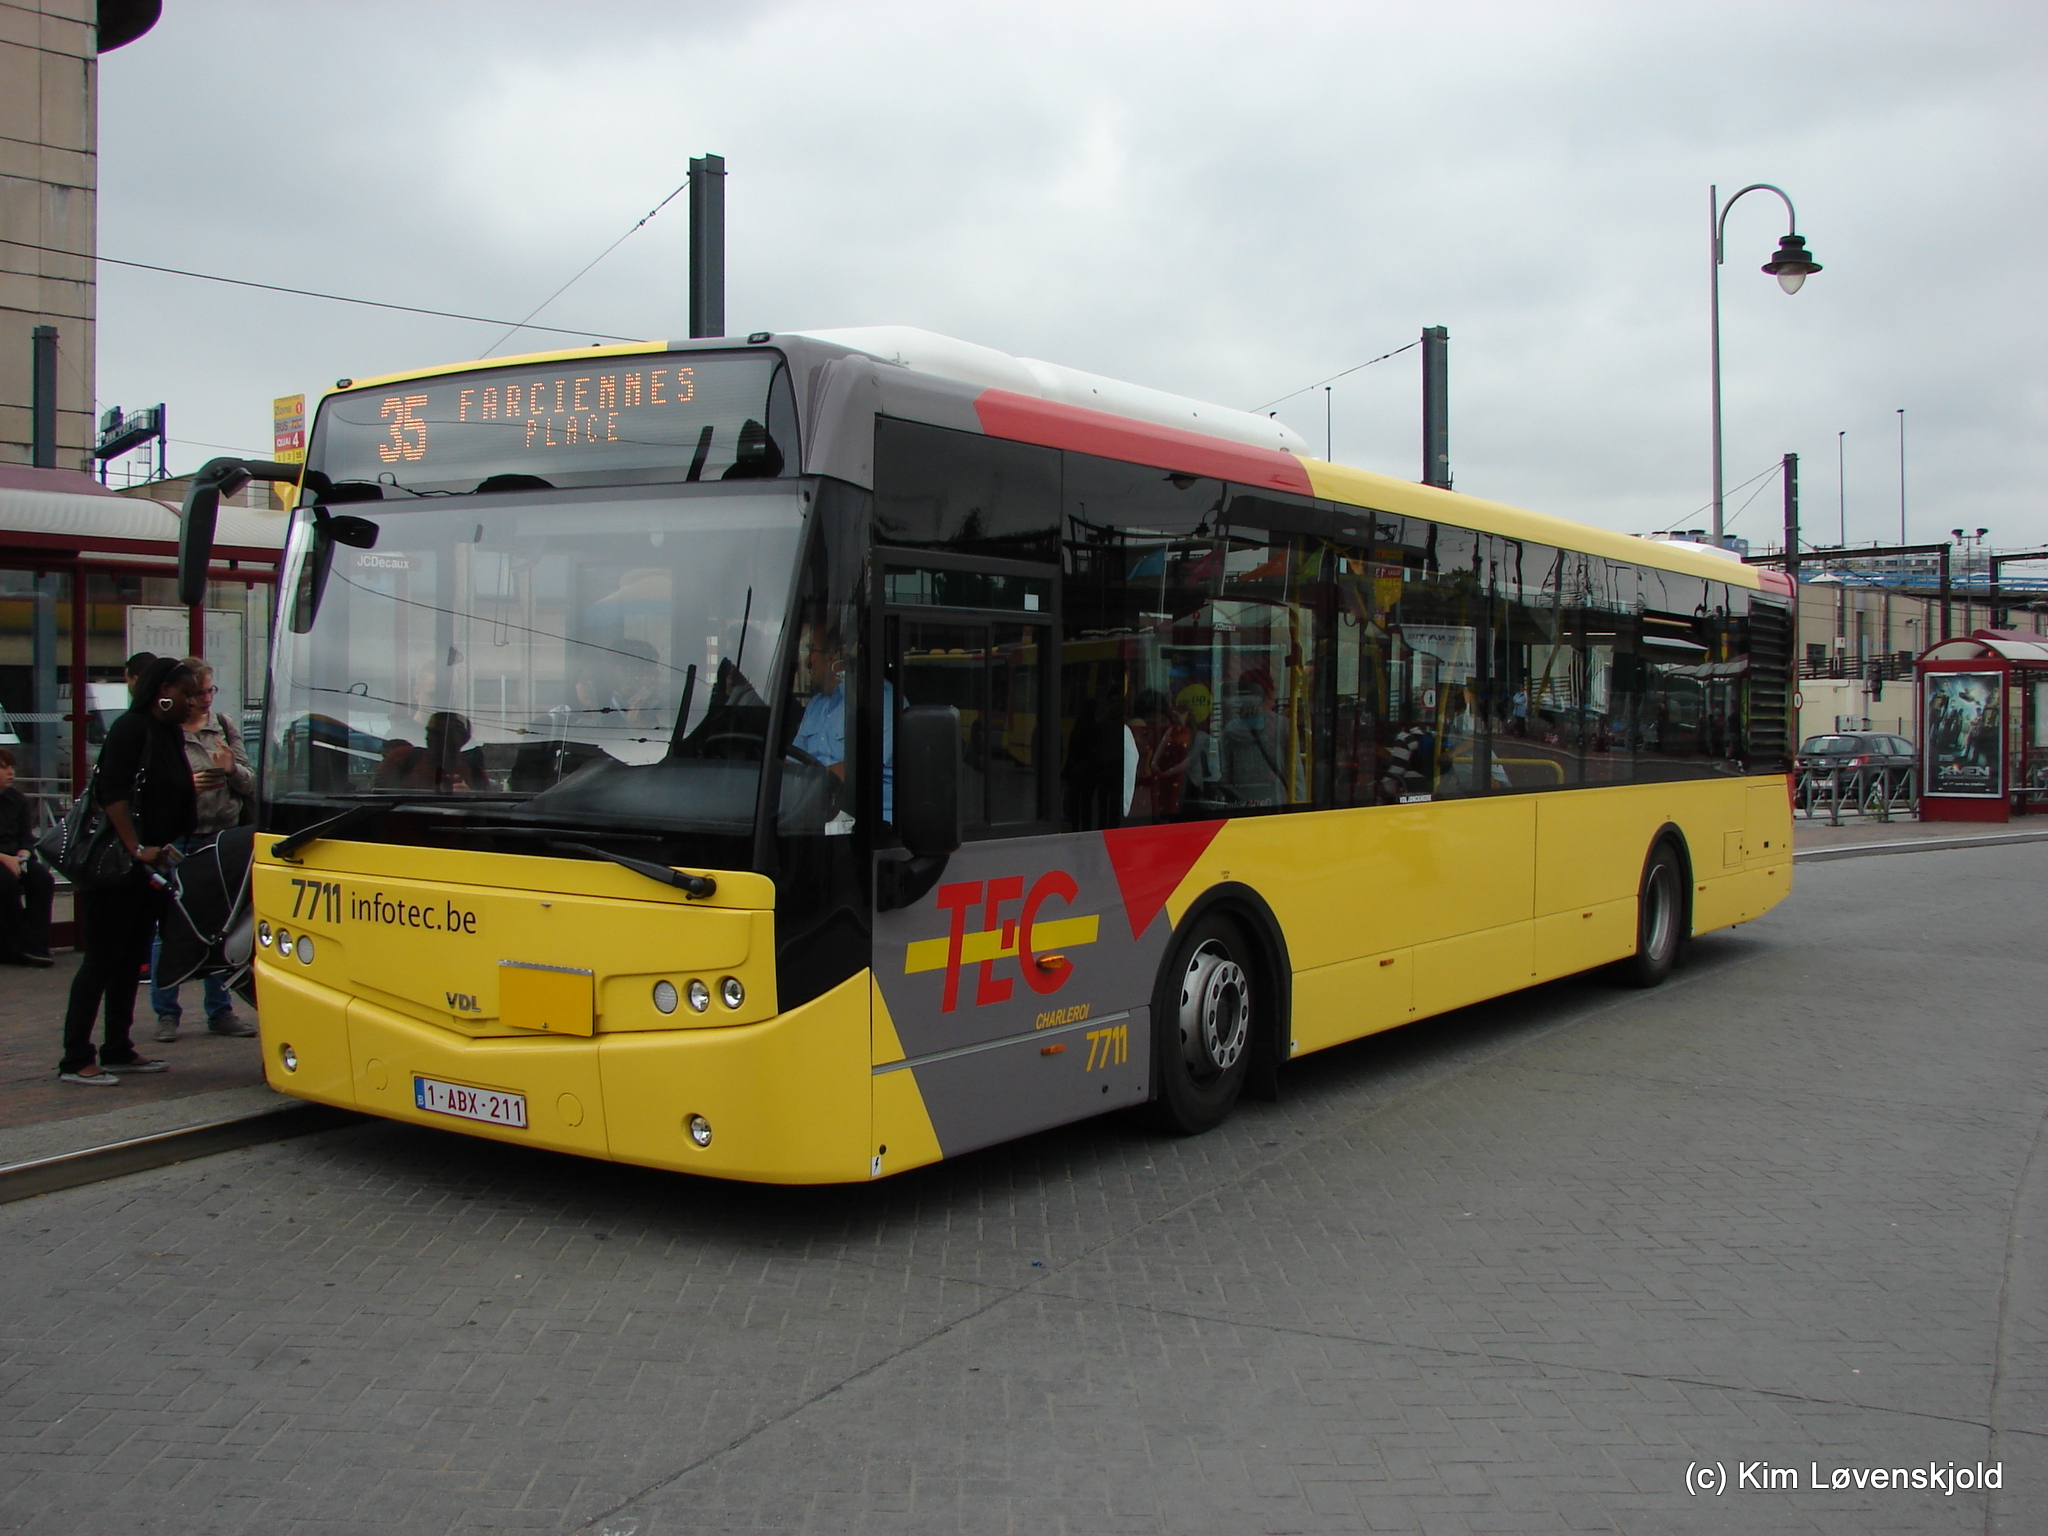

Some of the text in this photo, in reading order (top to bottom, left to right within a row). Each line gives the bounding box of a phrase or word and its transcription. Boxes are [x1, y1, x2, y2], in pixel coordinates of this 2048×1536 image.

[459, 367, 695, 422] FARCIENNES
[276, 432, 299, 447] QUAI 4
[379, 394, 428, 462] 35
[526, 412, 618, 447] PLACE
[357, 555, 410, 569] JCDecaux
[292, 879, 342, 924] 7711
[352, 892, 477, 934] infotec.be
[936, 870, 1080, 1013] TEC
[446, 991, 482, 1013] VDL
[1035, 1003, 1090, 1030] CHARLEROI
[1086, 1024, 1128, 1072] 7711
[428, 1085, 522, 1122] 1-ABX-211
